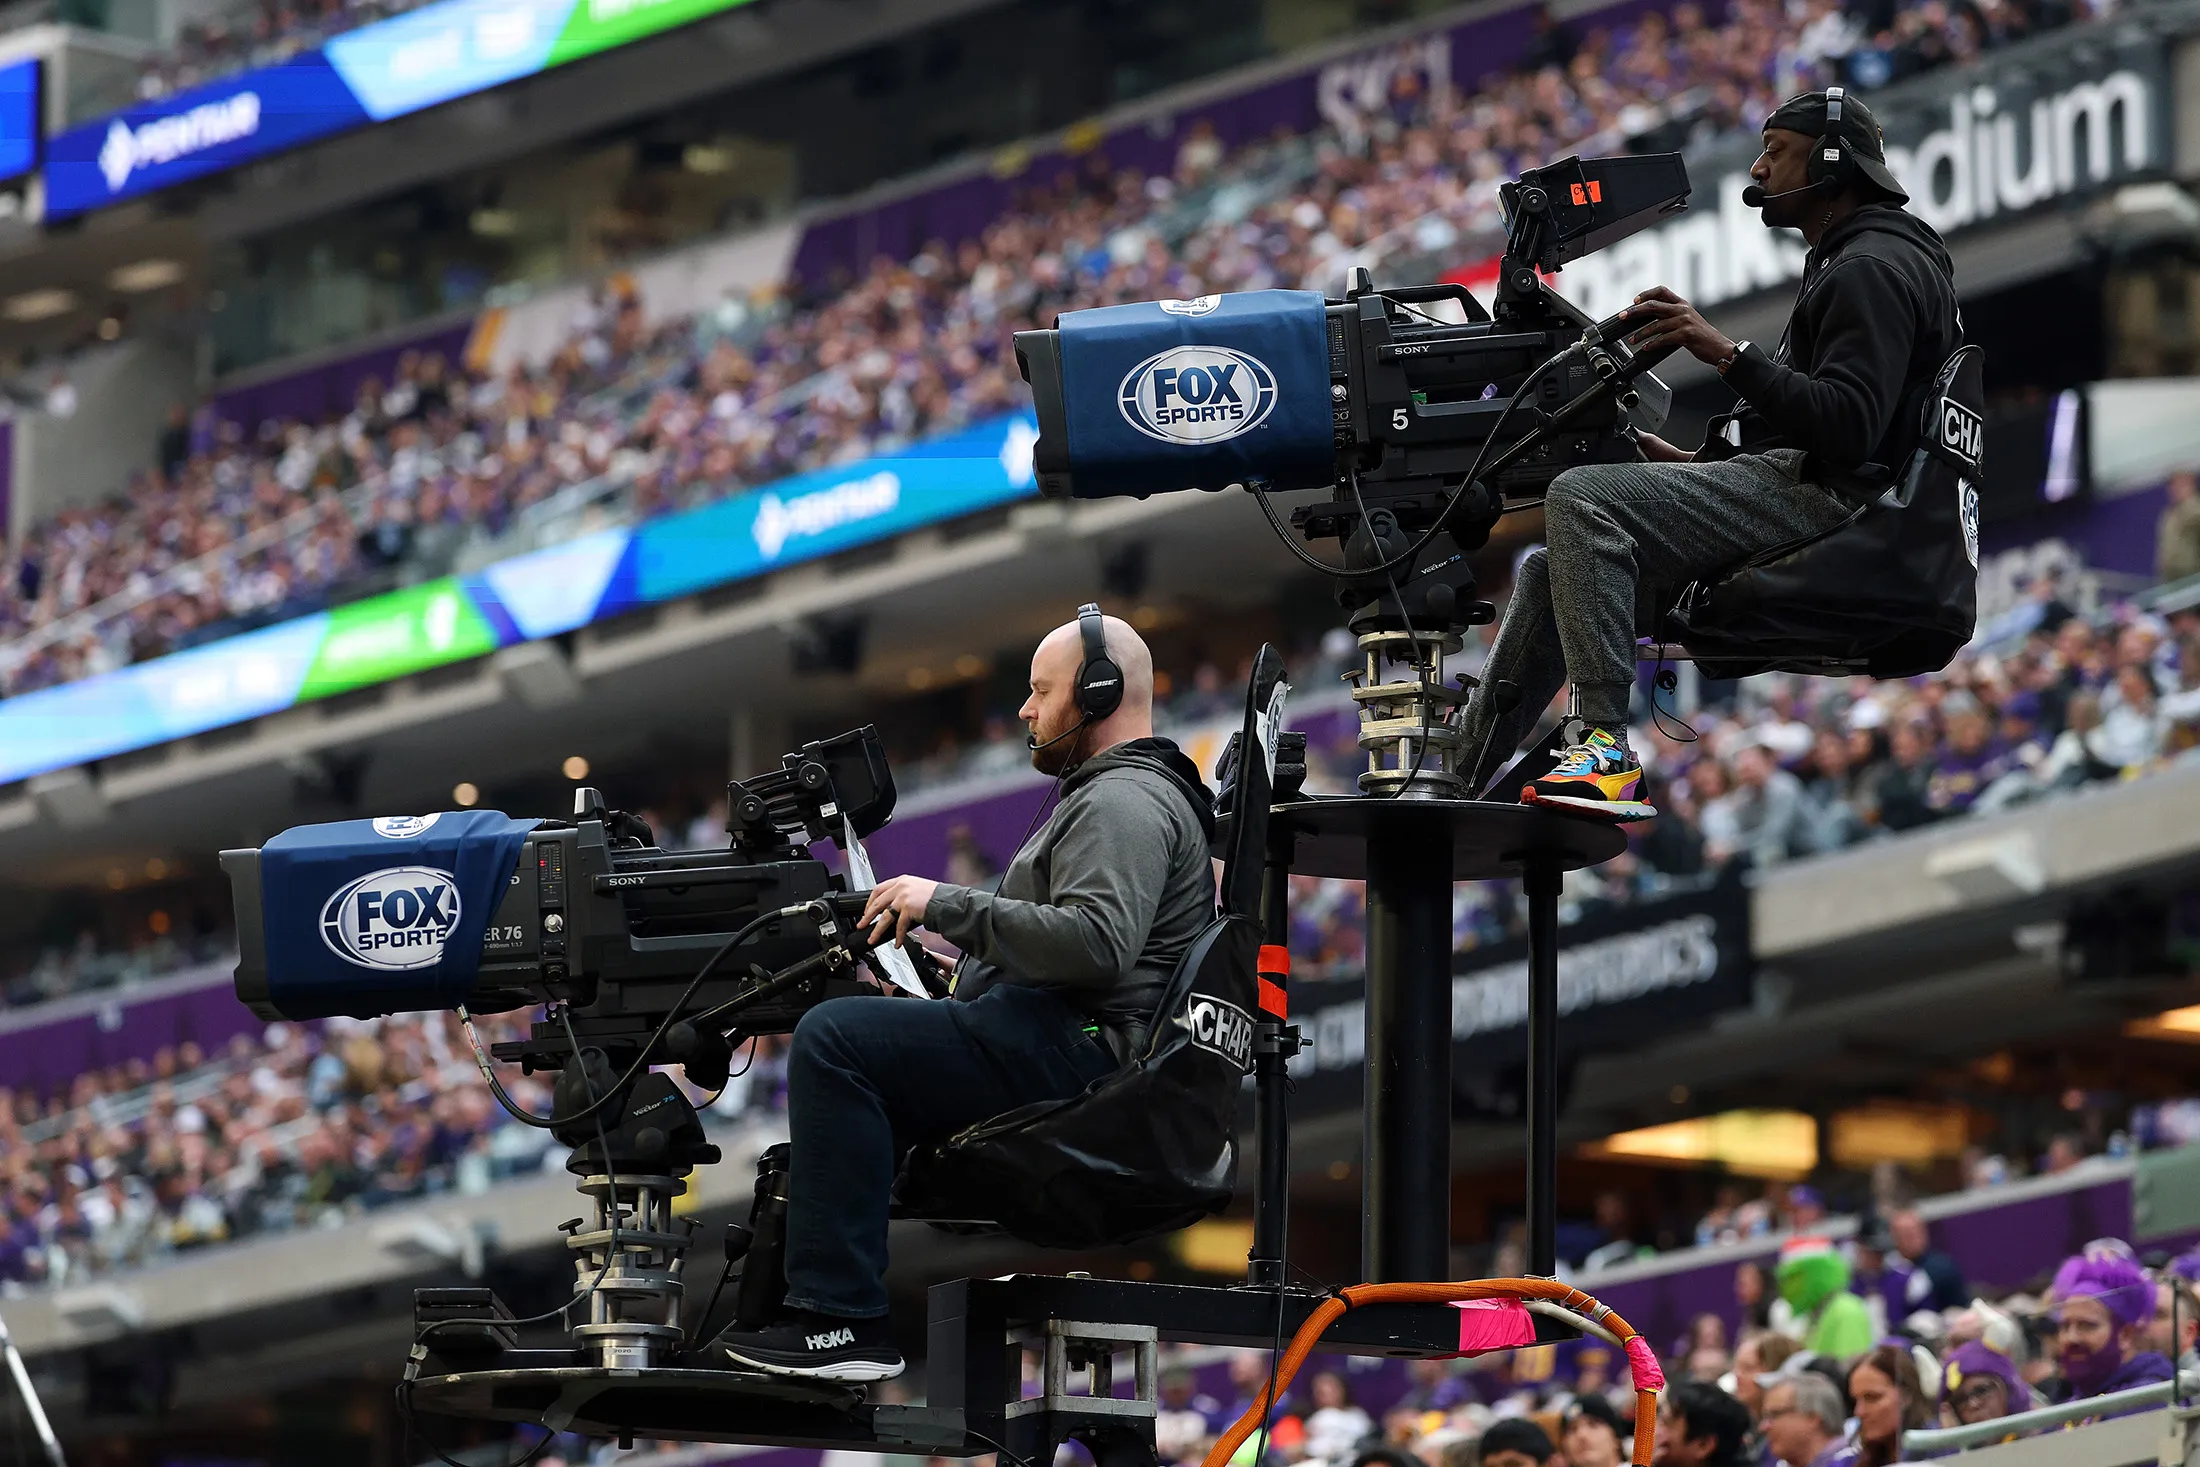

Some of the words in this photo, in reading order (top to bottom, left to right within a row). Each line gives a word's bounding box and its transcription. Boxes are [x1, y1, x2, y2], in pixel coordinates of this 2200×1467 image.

[1884, 74, 2150, 236] dium
[1394, 345, 1430, 355] SONY
[1153, 364, 1242, 408] FOX
[1155, 403, 1244, 425] SPORTS
[1392, 408, 1409, 431] 5
[1421, 560, 1449, 575] Vector
[1084, 679, 1118, 690] BOSE
[609, 876, 646, 886] SONY
[357, 884, 448, 933] FOX
[358, 925, 448, 951] SPORTS
[504, 925, 523, 940] 76
[633, 1101, 661, 1116] Vector
[663, 1095, 675, 1103] 75
[805, 1327, 855, 1350] HOKA
